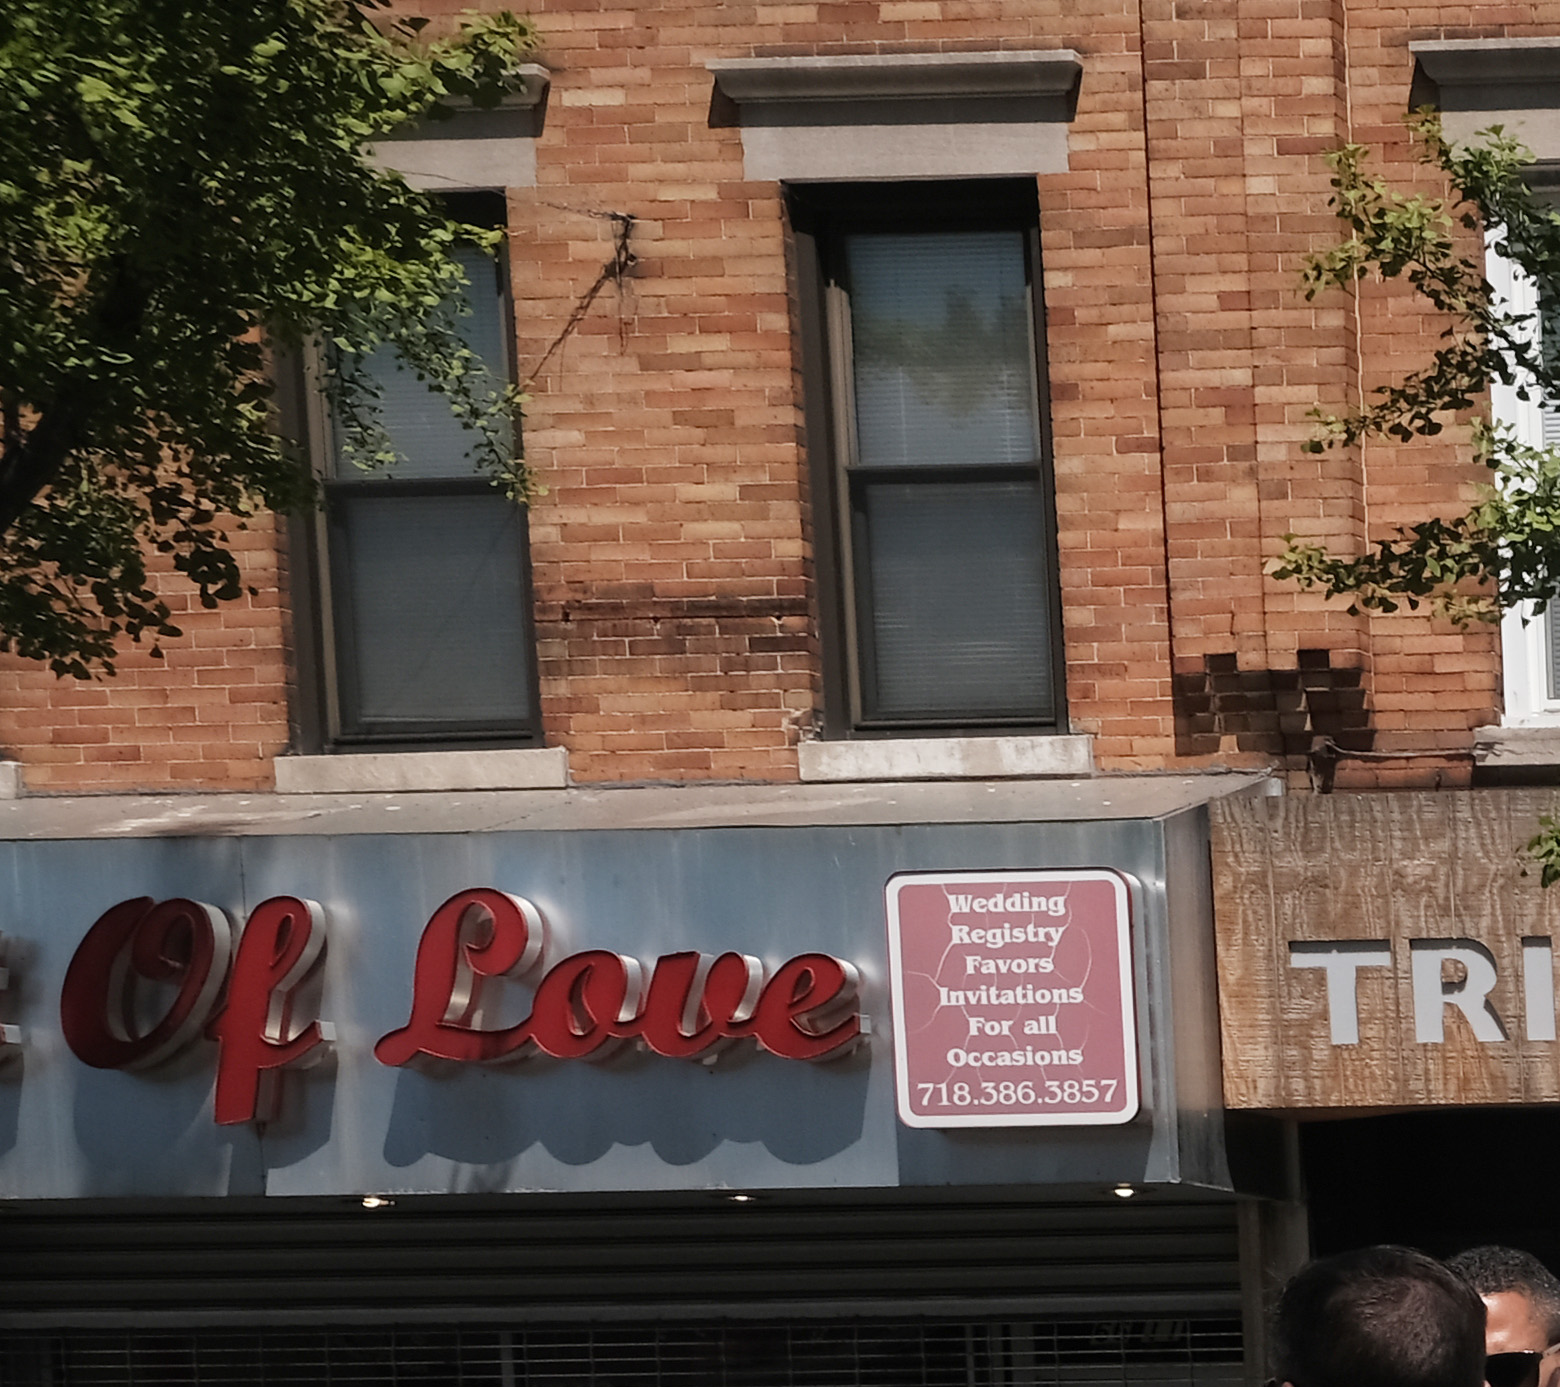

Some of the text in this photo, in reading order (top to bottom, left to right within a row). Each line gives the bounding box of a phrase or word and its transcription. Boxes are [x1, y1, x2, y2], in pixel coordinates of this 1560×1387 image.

[948, 892, 1066, 916] Wedding
[951, 923, 1064, 948] Registry
[965, 955, 1054, 975] Favors
[60, 886, 868, 1126] Of Love
[940, 984, 1084, 1006] Invitations
[968, 1016, 1057, 1036] For all
[946, 1046, 1084, 1067] Occasions
[917, 1079, 1118, 1106] 718.386.3857
